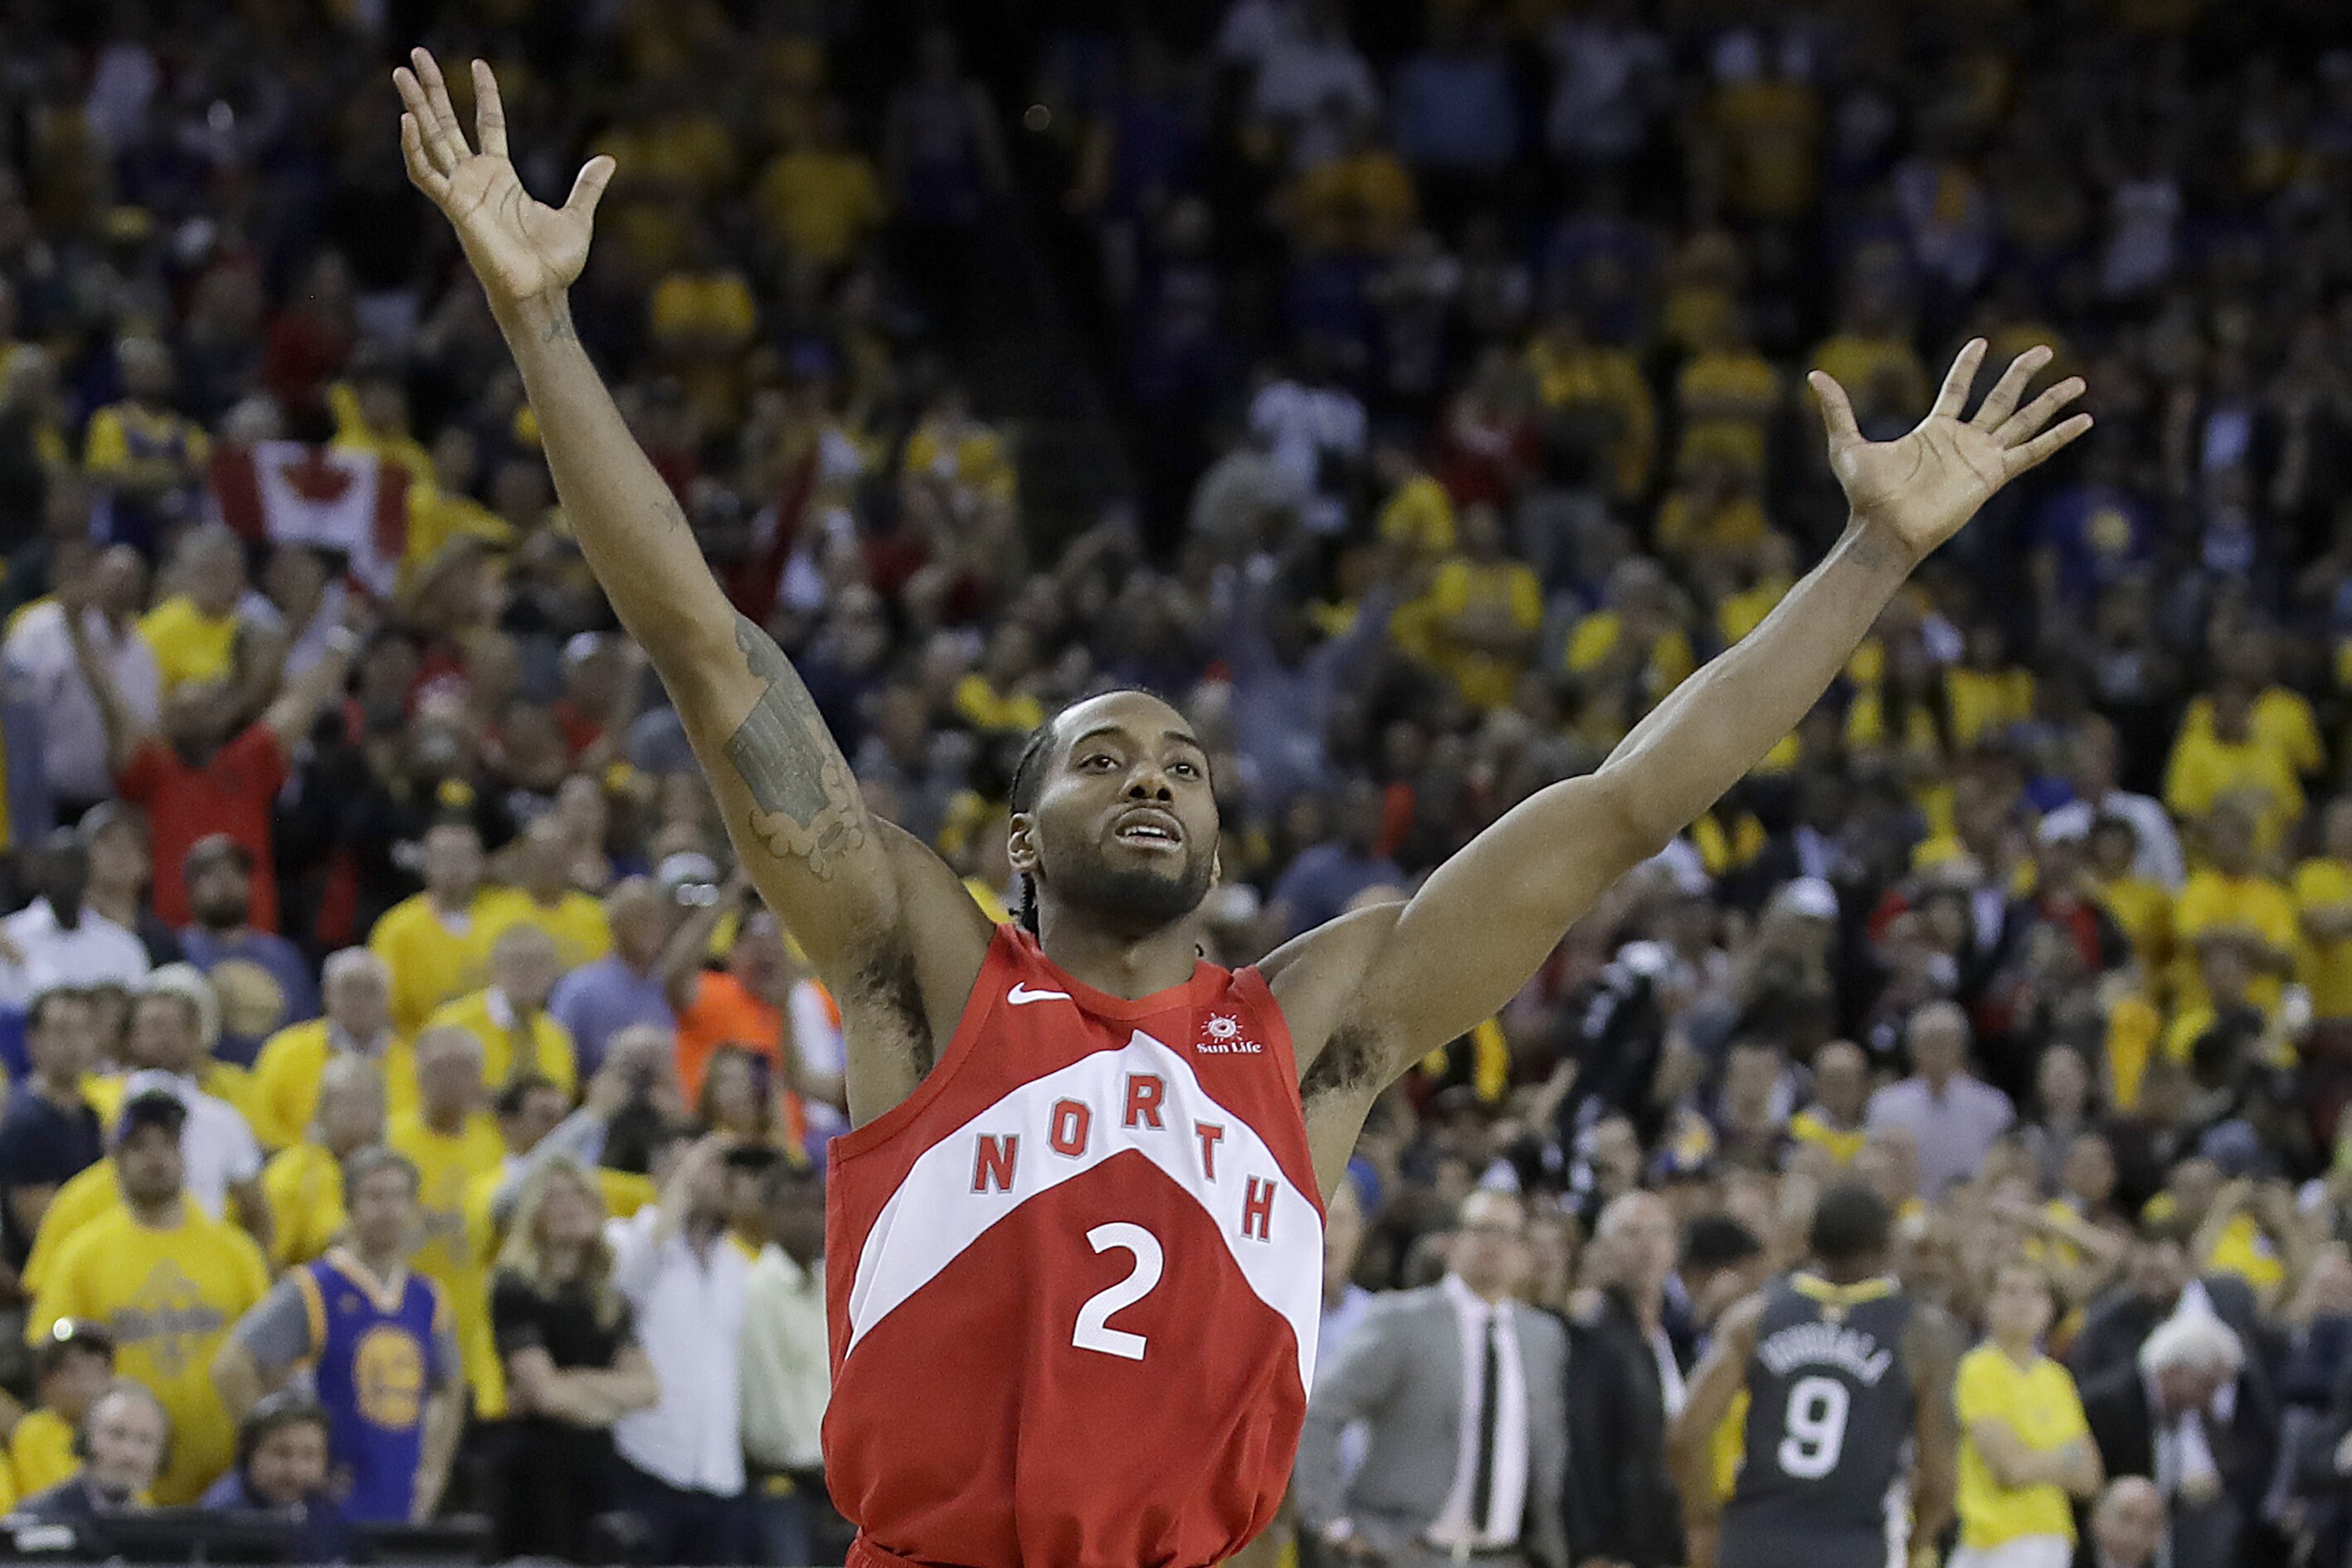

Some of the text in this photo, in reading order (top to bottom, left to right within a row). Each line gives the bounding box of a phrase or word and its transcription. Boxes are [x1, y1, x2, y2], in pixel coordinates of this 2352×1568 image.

[1196, 1041, 1262, 1053] Sun Life
[970, 1072, 1278, 1244] NORTH
[1072, 1222, 1164, 1361] 2
[1778, 1376, 1850, 1479] 9
